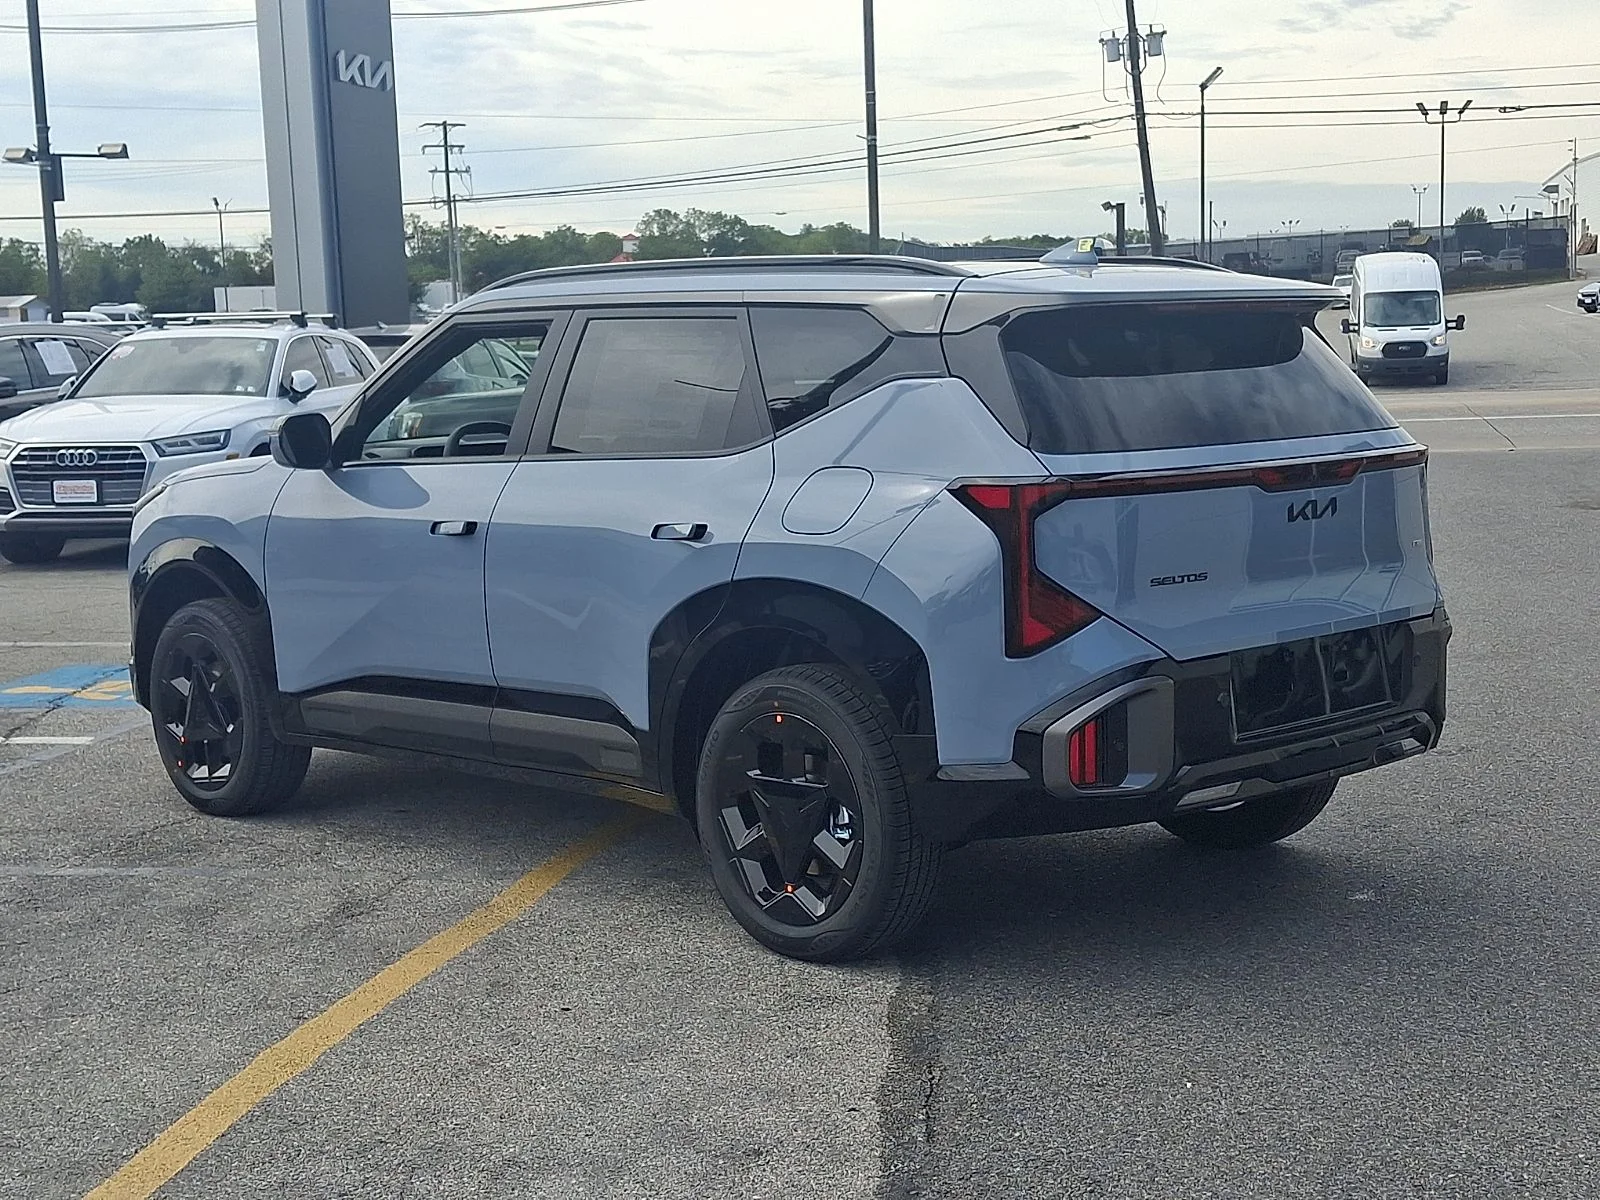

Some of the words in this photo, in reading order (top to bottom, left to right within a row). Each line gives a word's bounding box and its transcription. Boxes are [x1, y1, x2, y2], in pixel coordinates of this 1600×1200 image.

[336, 50, 392, 91] KIA
[1287, 496, 1337, 523] KIA
[1150, 572, 1208, 587] SELTOS
